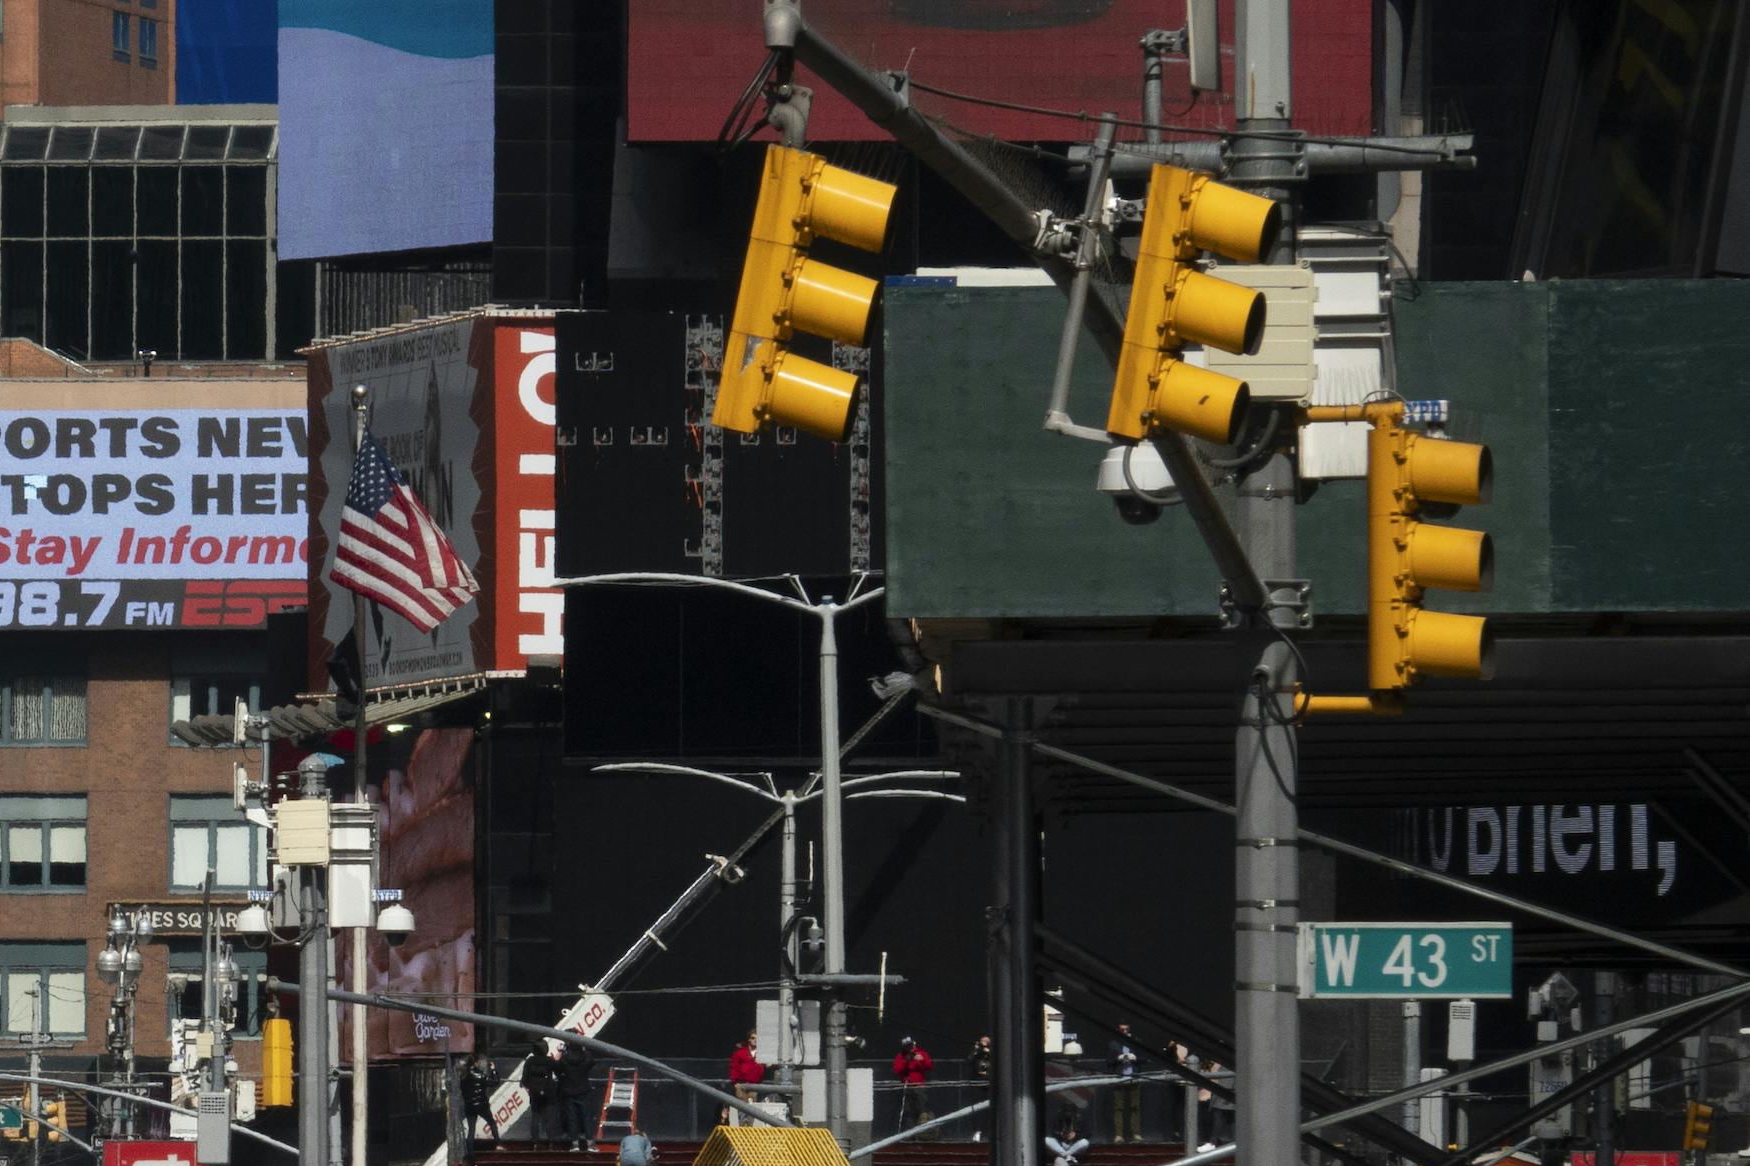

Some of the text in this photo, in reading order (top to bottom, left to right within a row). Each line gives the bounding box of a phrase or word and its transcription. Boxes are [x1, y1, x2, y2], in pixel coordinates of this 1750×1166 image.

[126, 602, 175, 626] FM
[375, 889, 400, 900] NYPD
[1321, 933, 1502, 988] W 43 ST
[415, 1022, 451, 1043] Garden
